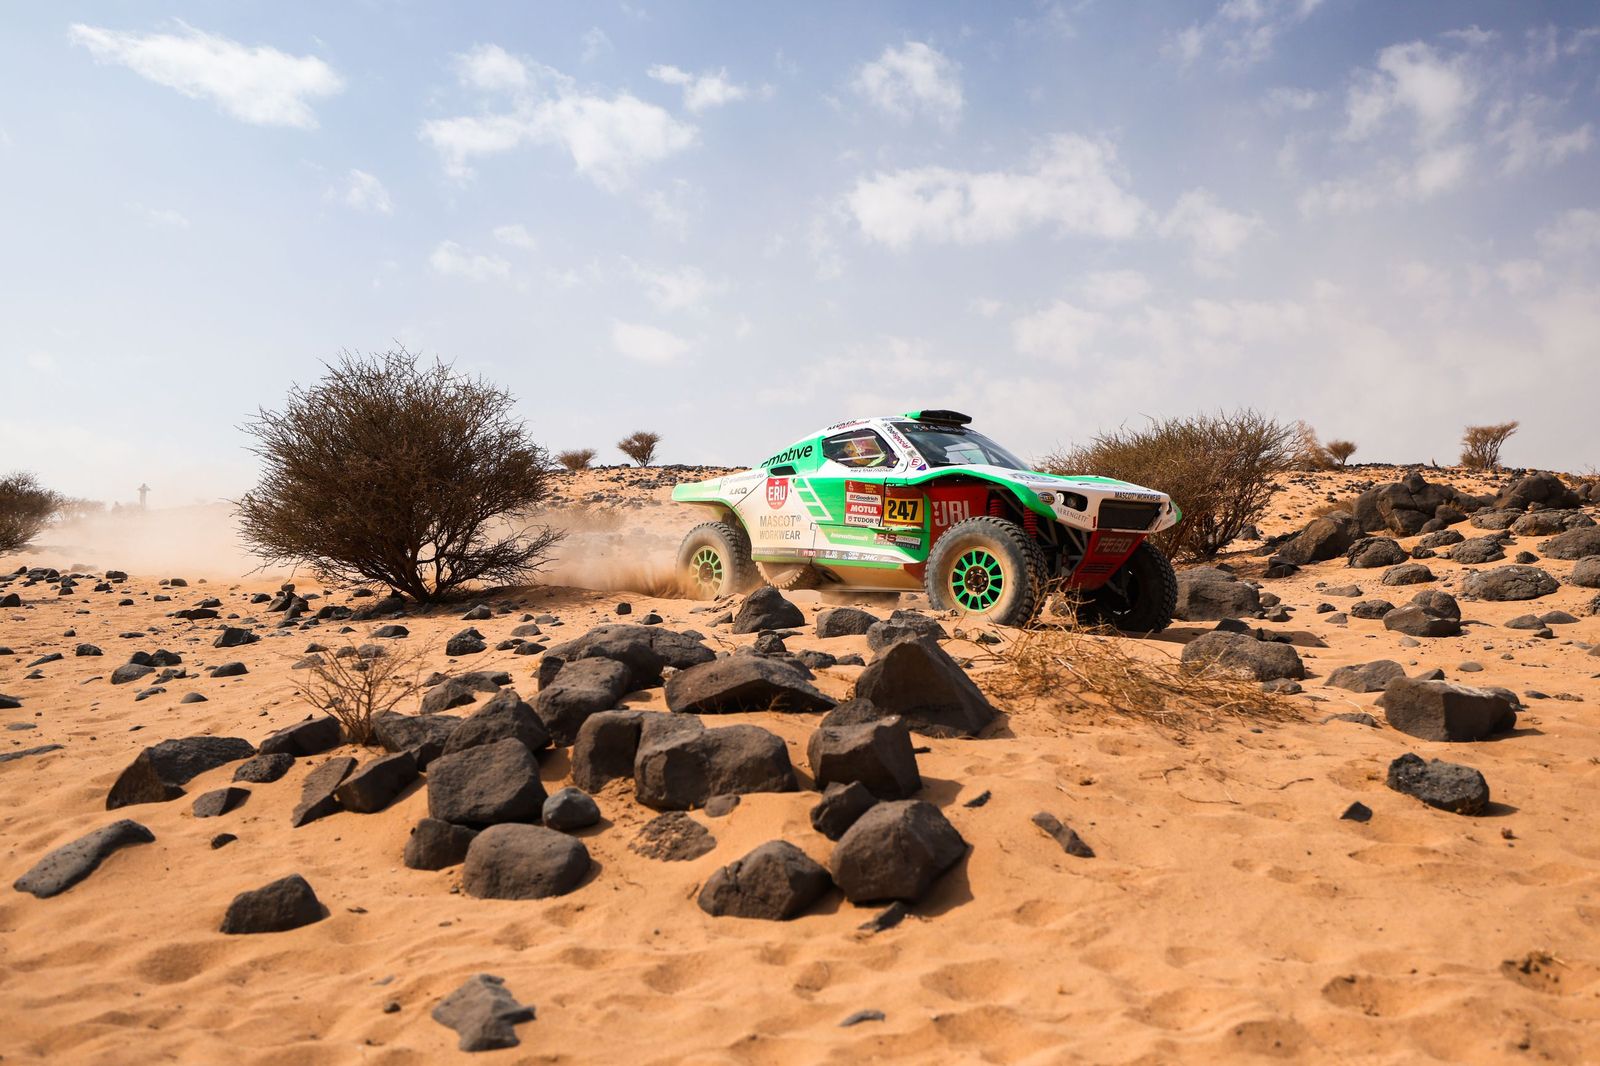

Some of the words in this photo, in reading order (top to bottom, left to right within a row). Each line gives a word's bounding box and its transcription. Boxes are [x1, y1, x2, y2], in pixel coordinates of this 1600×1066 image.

[729, 487, 748, 495] LKQ
[768, 486, 786, 501] ERU
[1137, 493, 1161, 501] WORKWEAR
[850, 505, 878, 514] MOTUL
[887, 500, 919, 521] 247
[853, 516, 874, 524] TUDOR
[760, 530, 801, 540] WORKWEAR
